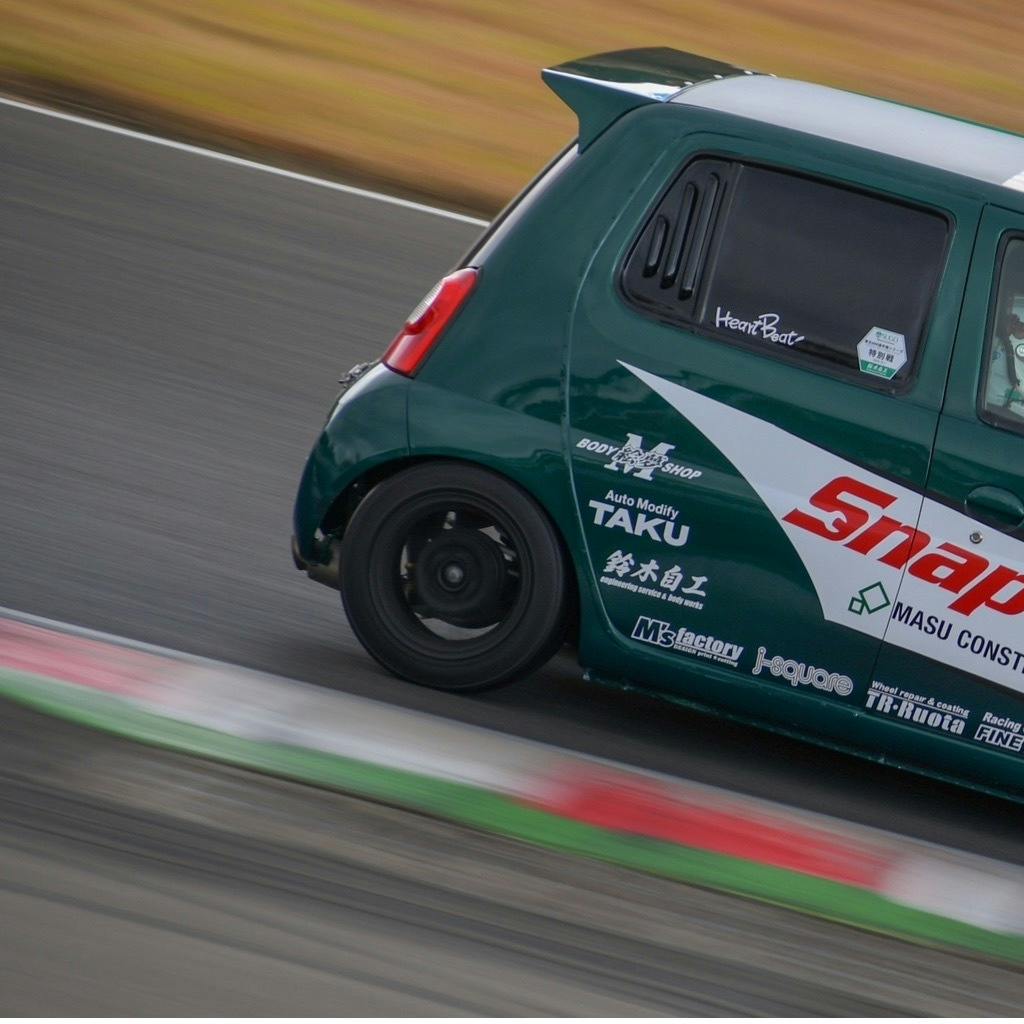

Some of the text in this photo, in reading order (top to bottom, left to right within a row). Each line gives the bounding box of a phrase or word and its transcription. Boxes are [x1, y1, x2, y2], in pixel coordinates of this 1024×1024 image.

[576, 438, 616, 456] BODY
[661, 462, 703, 480] SHOP
[588, 500, 690, 547] TAKU
[604, 489, 679, 520] Auto Modify
[602, 549, 709, 597] 鈴木自工
[631, 616, 744, 661] M's factory
[891, 601, 953, 641] MASU
[752, 646, 854, 697] j-square
[871, 680, 970, 718] Wheel repair & coating
[982, 711, 1021, 734] Racing
